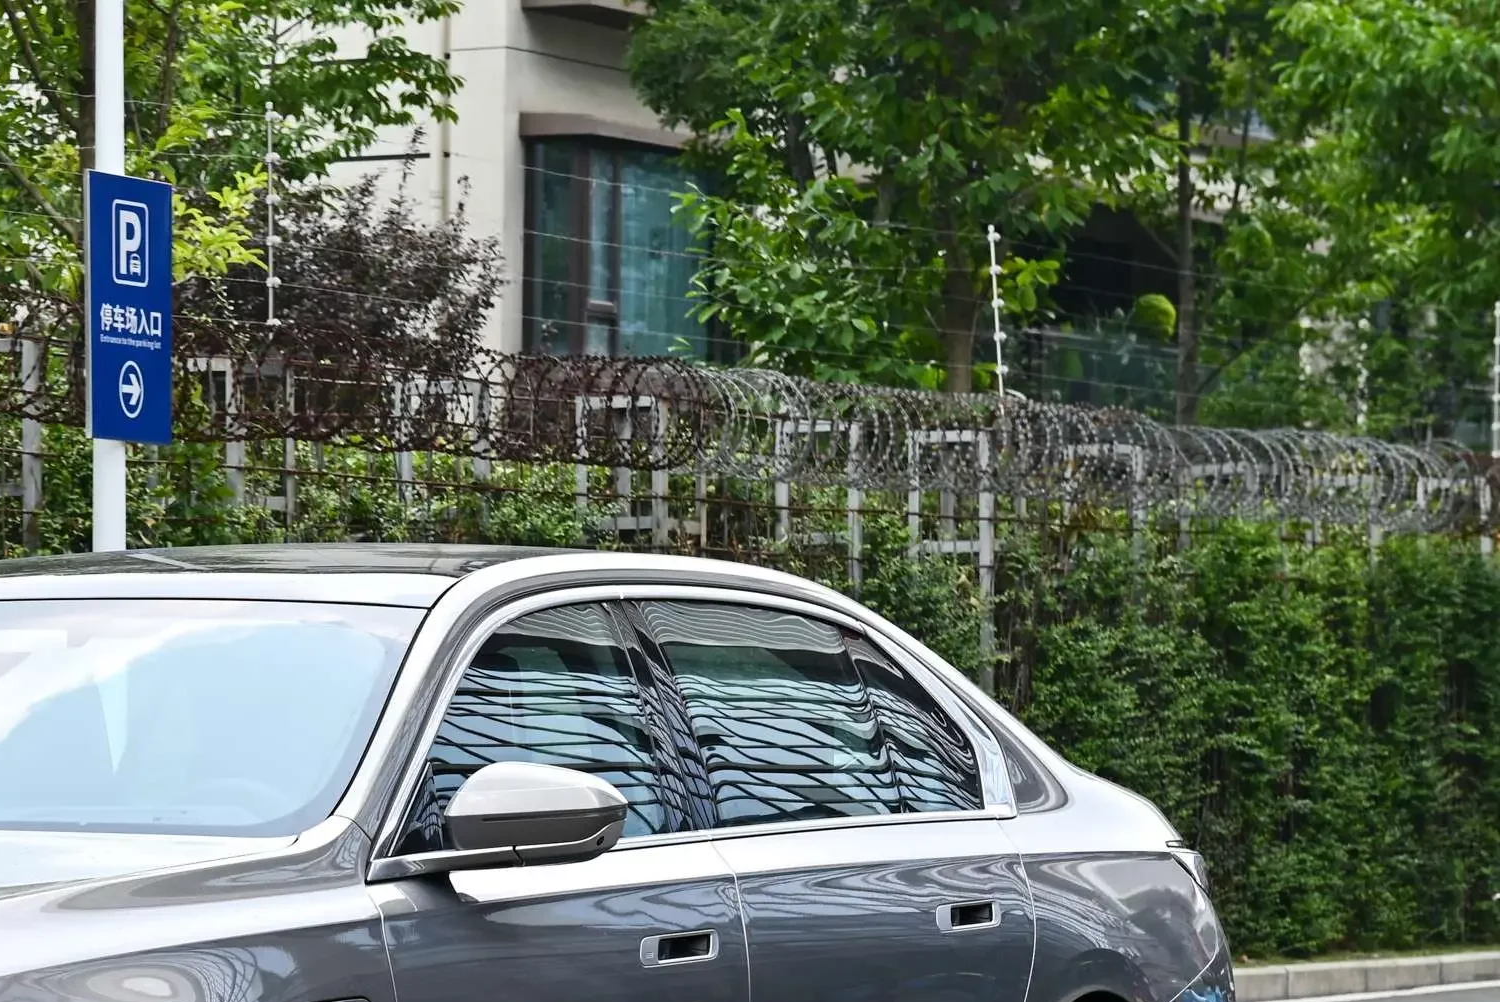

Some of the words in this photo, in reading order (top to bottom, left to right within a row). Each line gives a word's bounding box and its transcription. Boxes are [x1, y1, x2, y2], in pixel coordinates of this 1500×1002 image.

[119, 209, 142, 275] P
[100, 303, 162, 338] 停车场入口
